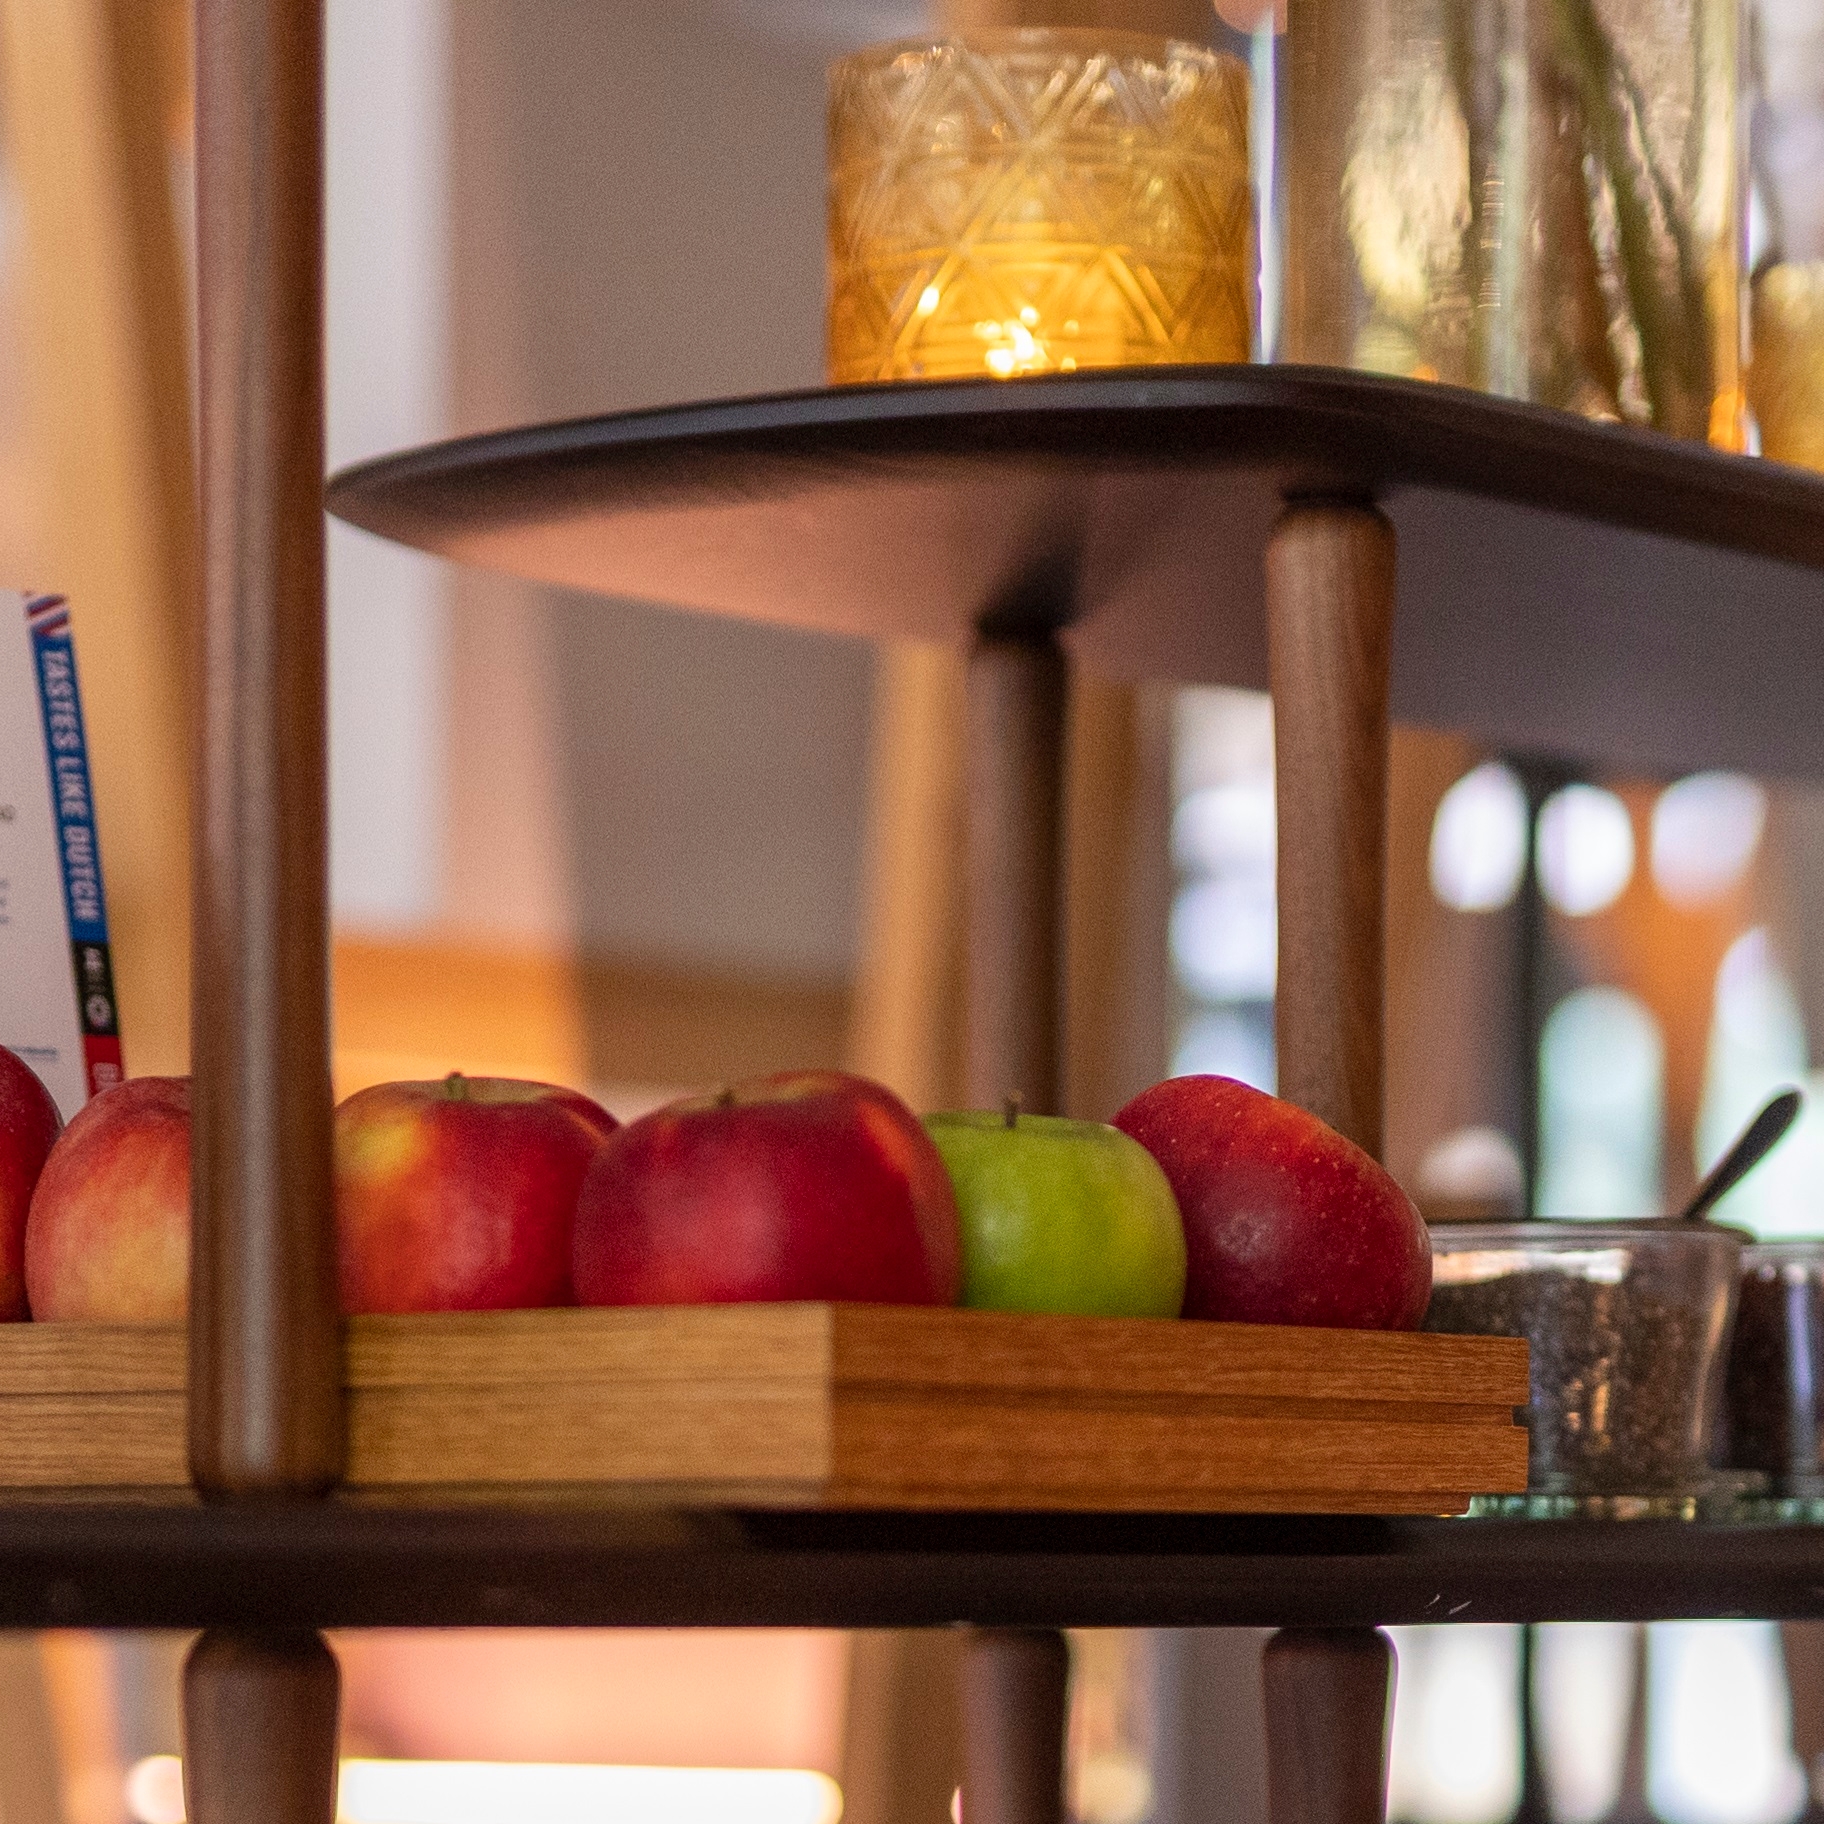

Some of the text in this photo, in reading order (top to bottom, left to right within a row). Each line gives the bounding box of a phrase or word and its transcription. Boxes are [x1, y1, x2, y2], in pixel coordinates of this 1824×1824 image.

[42, 651, 81, 751] TASTES
[55, 757, 90, 818] LIKE
[63, 825, 101, 922] DUTCH
